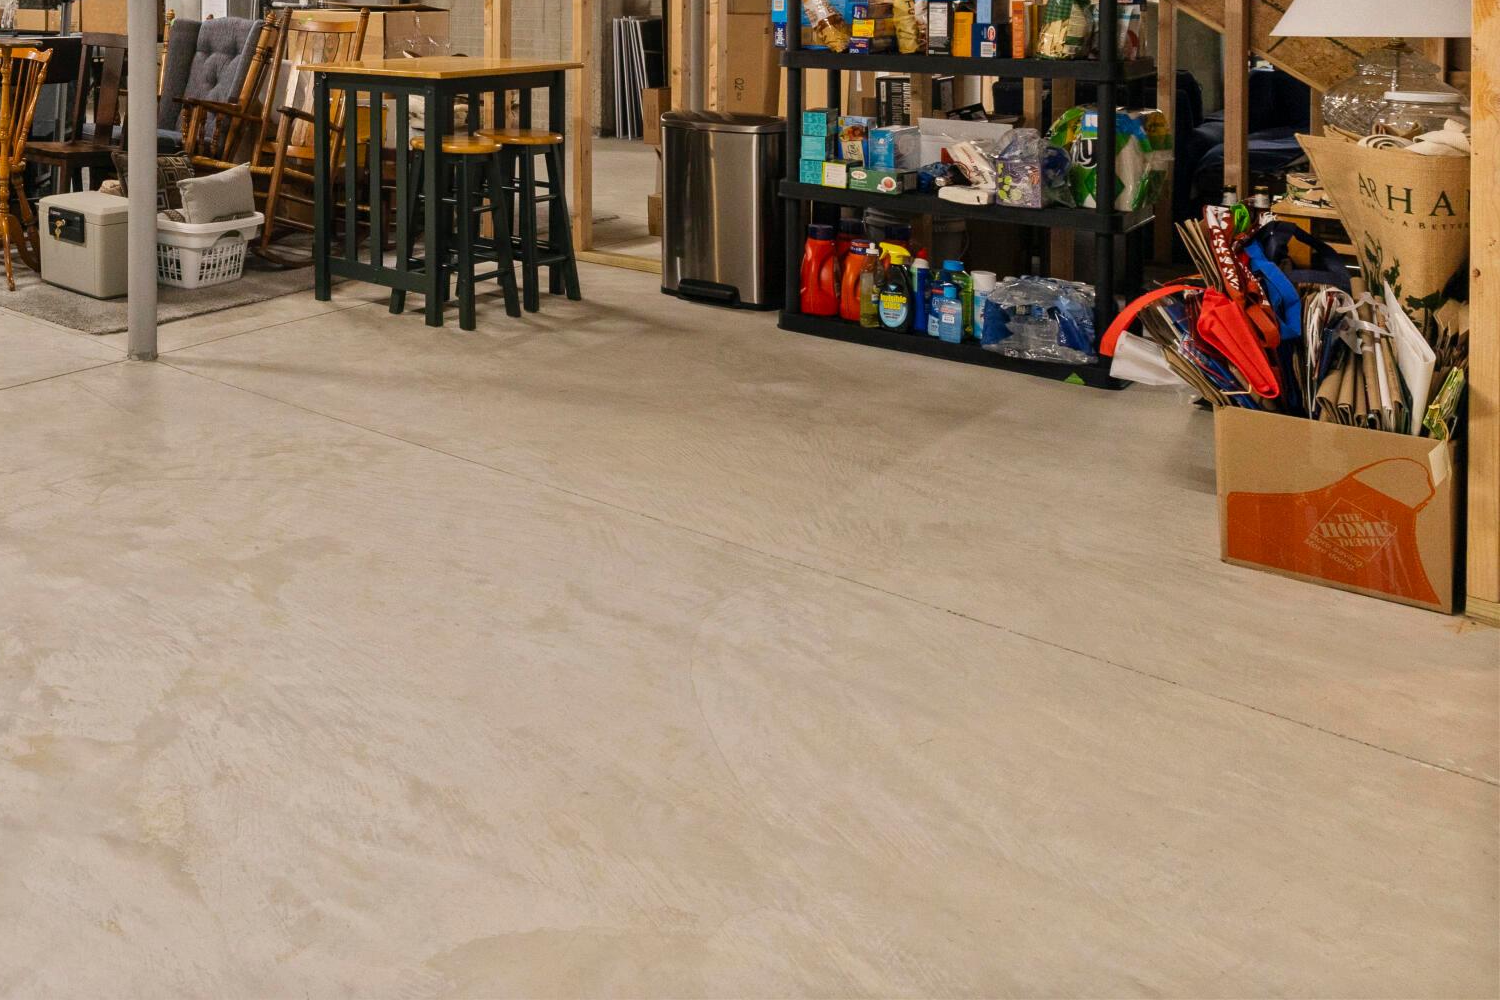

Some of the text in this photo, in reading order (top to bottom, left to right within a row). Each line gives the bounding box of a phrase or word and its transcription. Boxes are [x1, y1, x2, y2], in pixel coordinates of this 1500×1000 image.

[775, 27, 785, 46] Ziploc
[1358, 172, 1470, 216] ARHA
[880, 293, 907, 304] Invisible
[1334, 513, 1362, 522] THE
[1319, 521, 1391, 537] HOME
